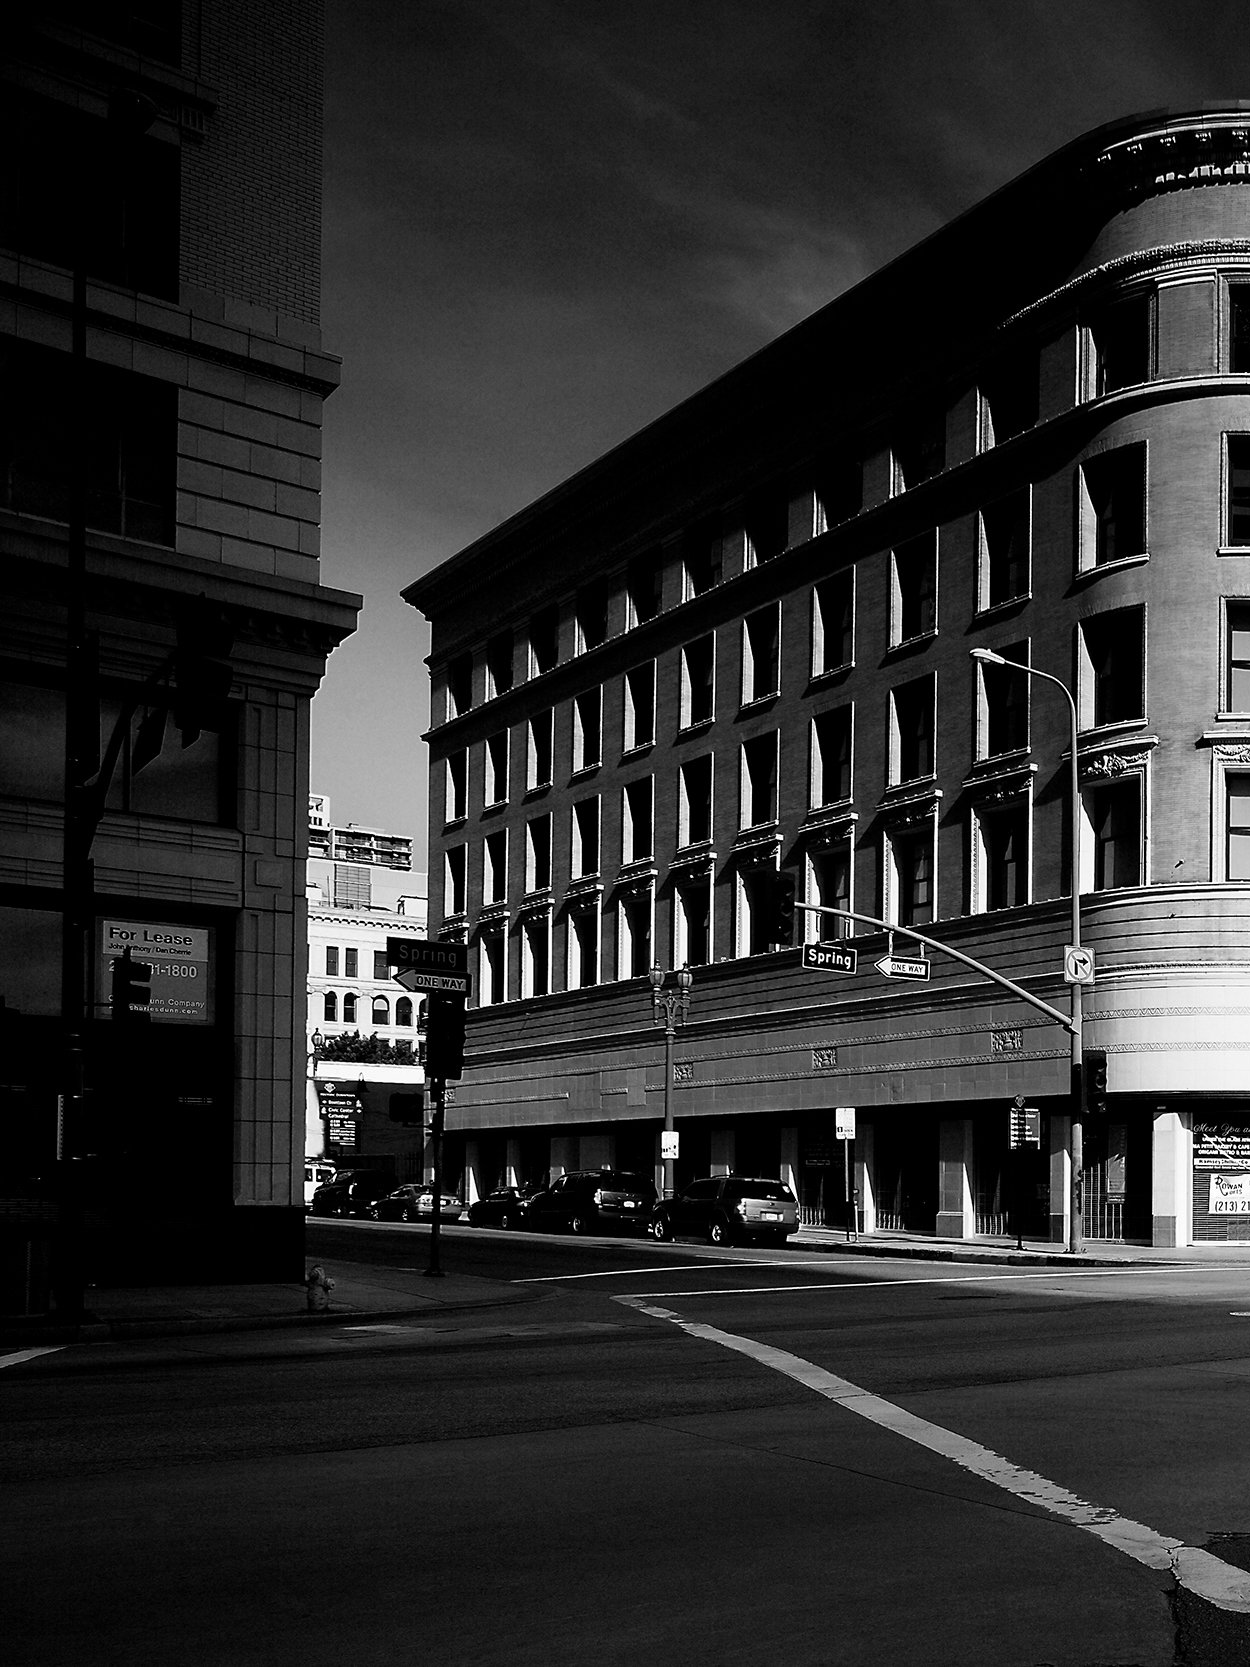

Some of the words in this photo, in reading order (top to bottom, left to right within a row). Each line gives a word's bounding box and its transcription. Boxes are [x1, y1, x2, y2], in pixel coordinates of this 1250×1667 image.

[110, 927, 136, 940] For
[144, 930, 192, 946] Lease
[400, 944, 456, 968] Spring
[808, 948, 852, 970] Spring
[891, 963, 906, 971] ONE
[907, 965, 923, 974] WAY
[417, 976, 438, 986] ONE
[442, 979, 464, 990] WAY
[168, 998, 204, 1008] Company
[1215, 1200, 1238, 1212] (213)
